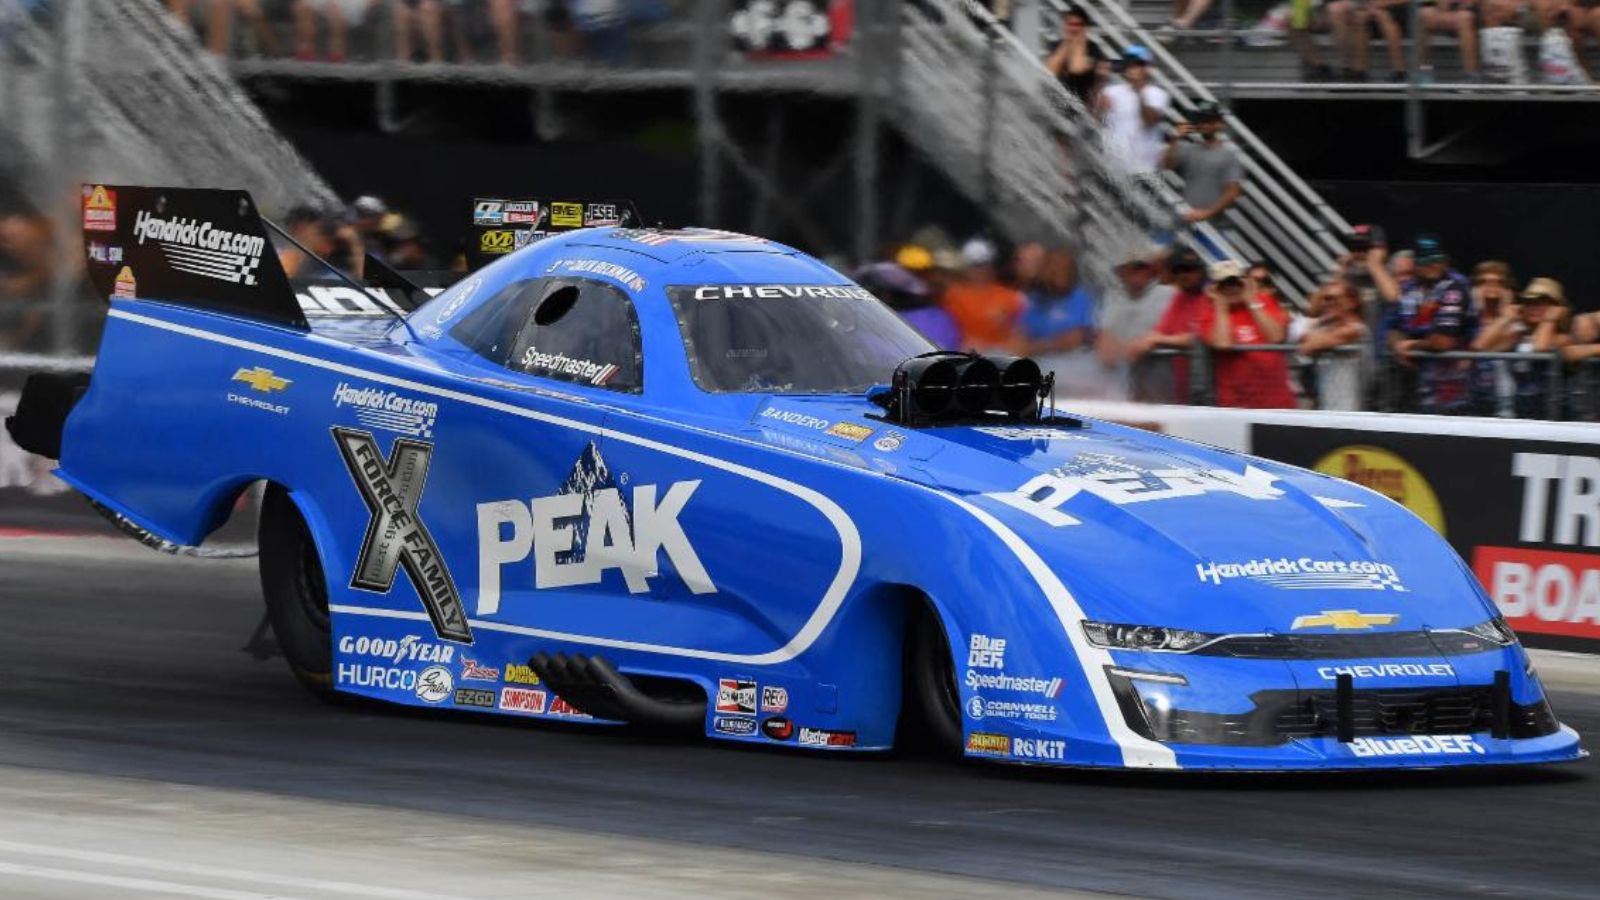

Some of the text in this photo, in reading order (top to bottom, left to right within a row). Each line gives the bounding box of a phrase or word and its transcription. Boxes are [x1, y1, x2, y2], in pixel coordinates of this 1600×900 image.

[585, 203, 619, 221] JESEL
[134, 210, 265, 256] HendrickCars.com
[227, 392, 290, 415] CHEVROLET
[333, 382, 438, 417] HendrickCars.com
[760, 407, 829, 430] BANDERO
[356, 443, 461, 626] FORCE FAMILY
[476, 479, 719, 616] PEAK
[1197, 558, 1397, 586] HendrickCars.com
[970, 634, 1006, 651] Blue
[338, 663, 417, 690] HURCO
[1318, 663, 1455, 681] CHEVROLET
[502, 690, 544, 711] SIMPSON
[987, 701, 1056, 714] CORNWELL
[986, 709, 1057, 721] QUALITY TOOLS
